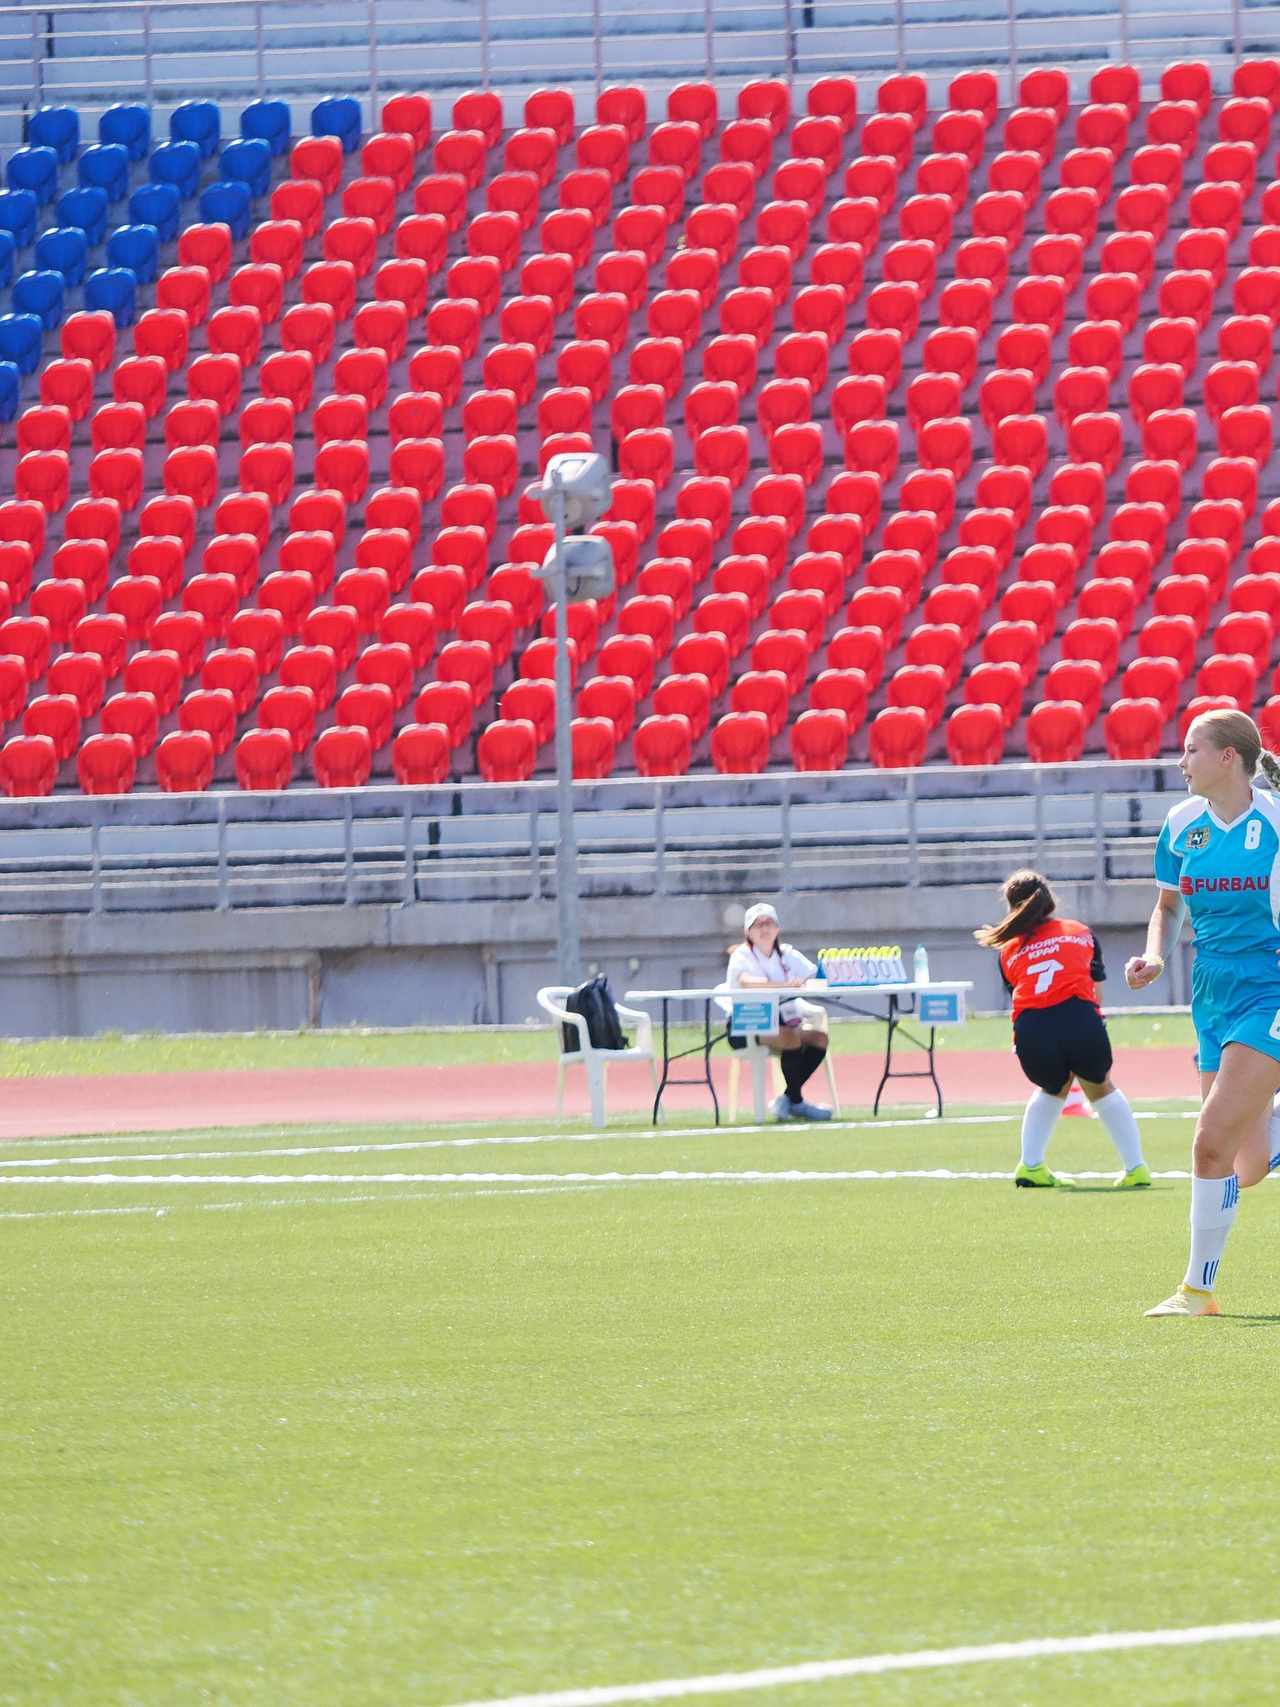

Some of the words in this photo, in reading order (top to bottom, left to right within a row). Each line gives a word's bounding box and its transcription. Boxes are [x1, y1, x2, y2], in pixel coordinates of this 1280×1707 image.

[1244, 819, 1262, 850] 8
[1195, 876, 1270, 892] FURBAU
[1026, 959, 1065, 995] 7
